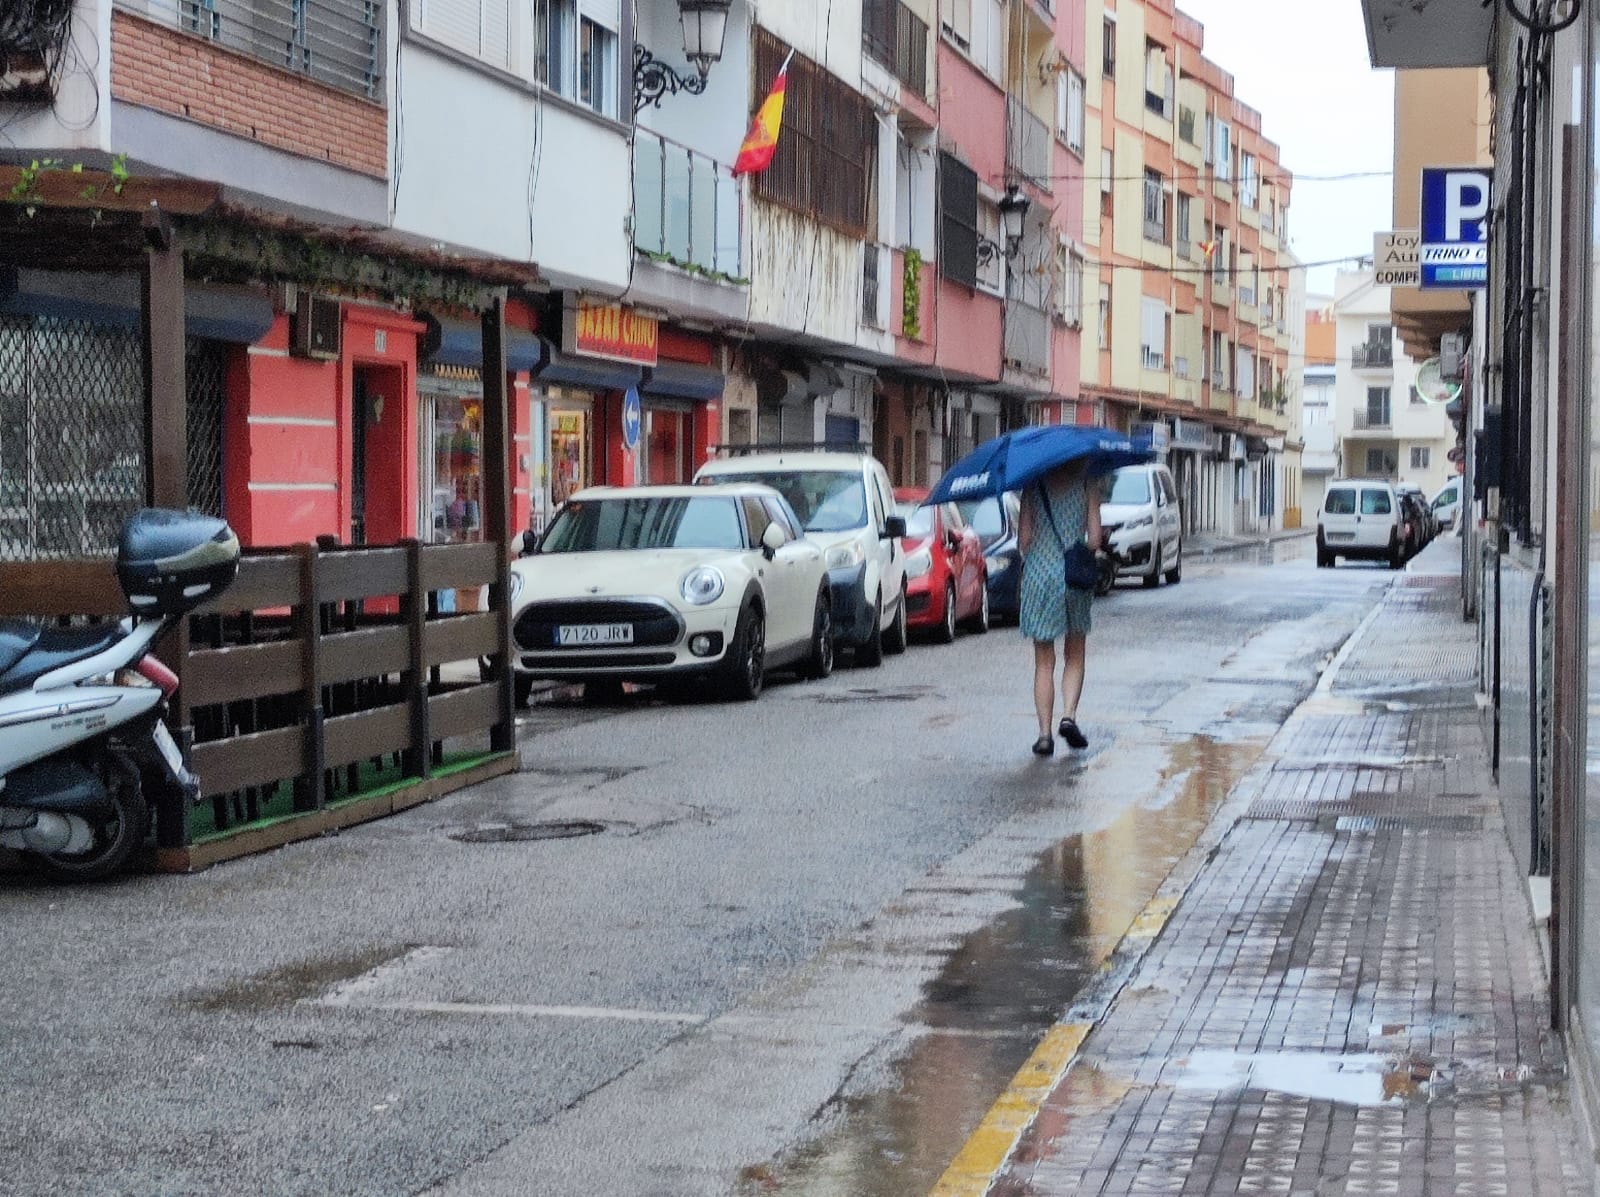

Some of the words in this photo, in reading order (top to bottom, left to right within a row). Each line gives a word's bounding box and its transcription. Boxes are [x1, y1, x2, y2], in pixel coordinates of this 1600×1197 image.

[1445, 172, 1489, 240] P
[1385, 234, 1419, 250] Joy
[1425, 247, 1470, 260] TRINO
[563, 627, 599, 641] 7120
